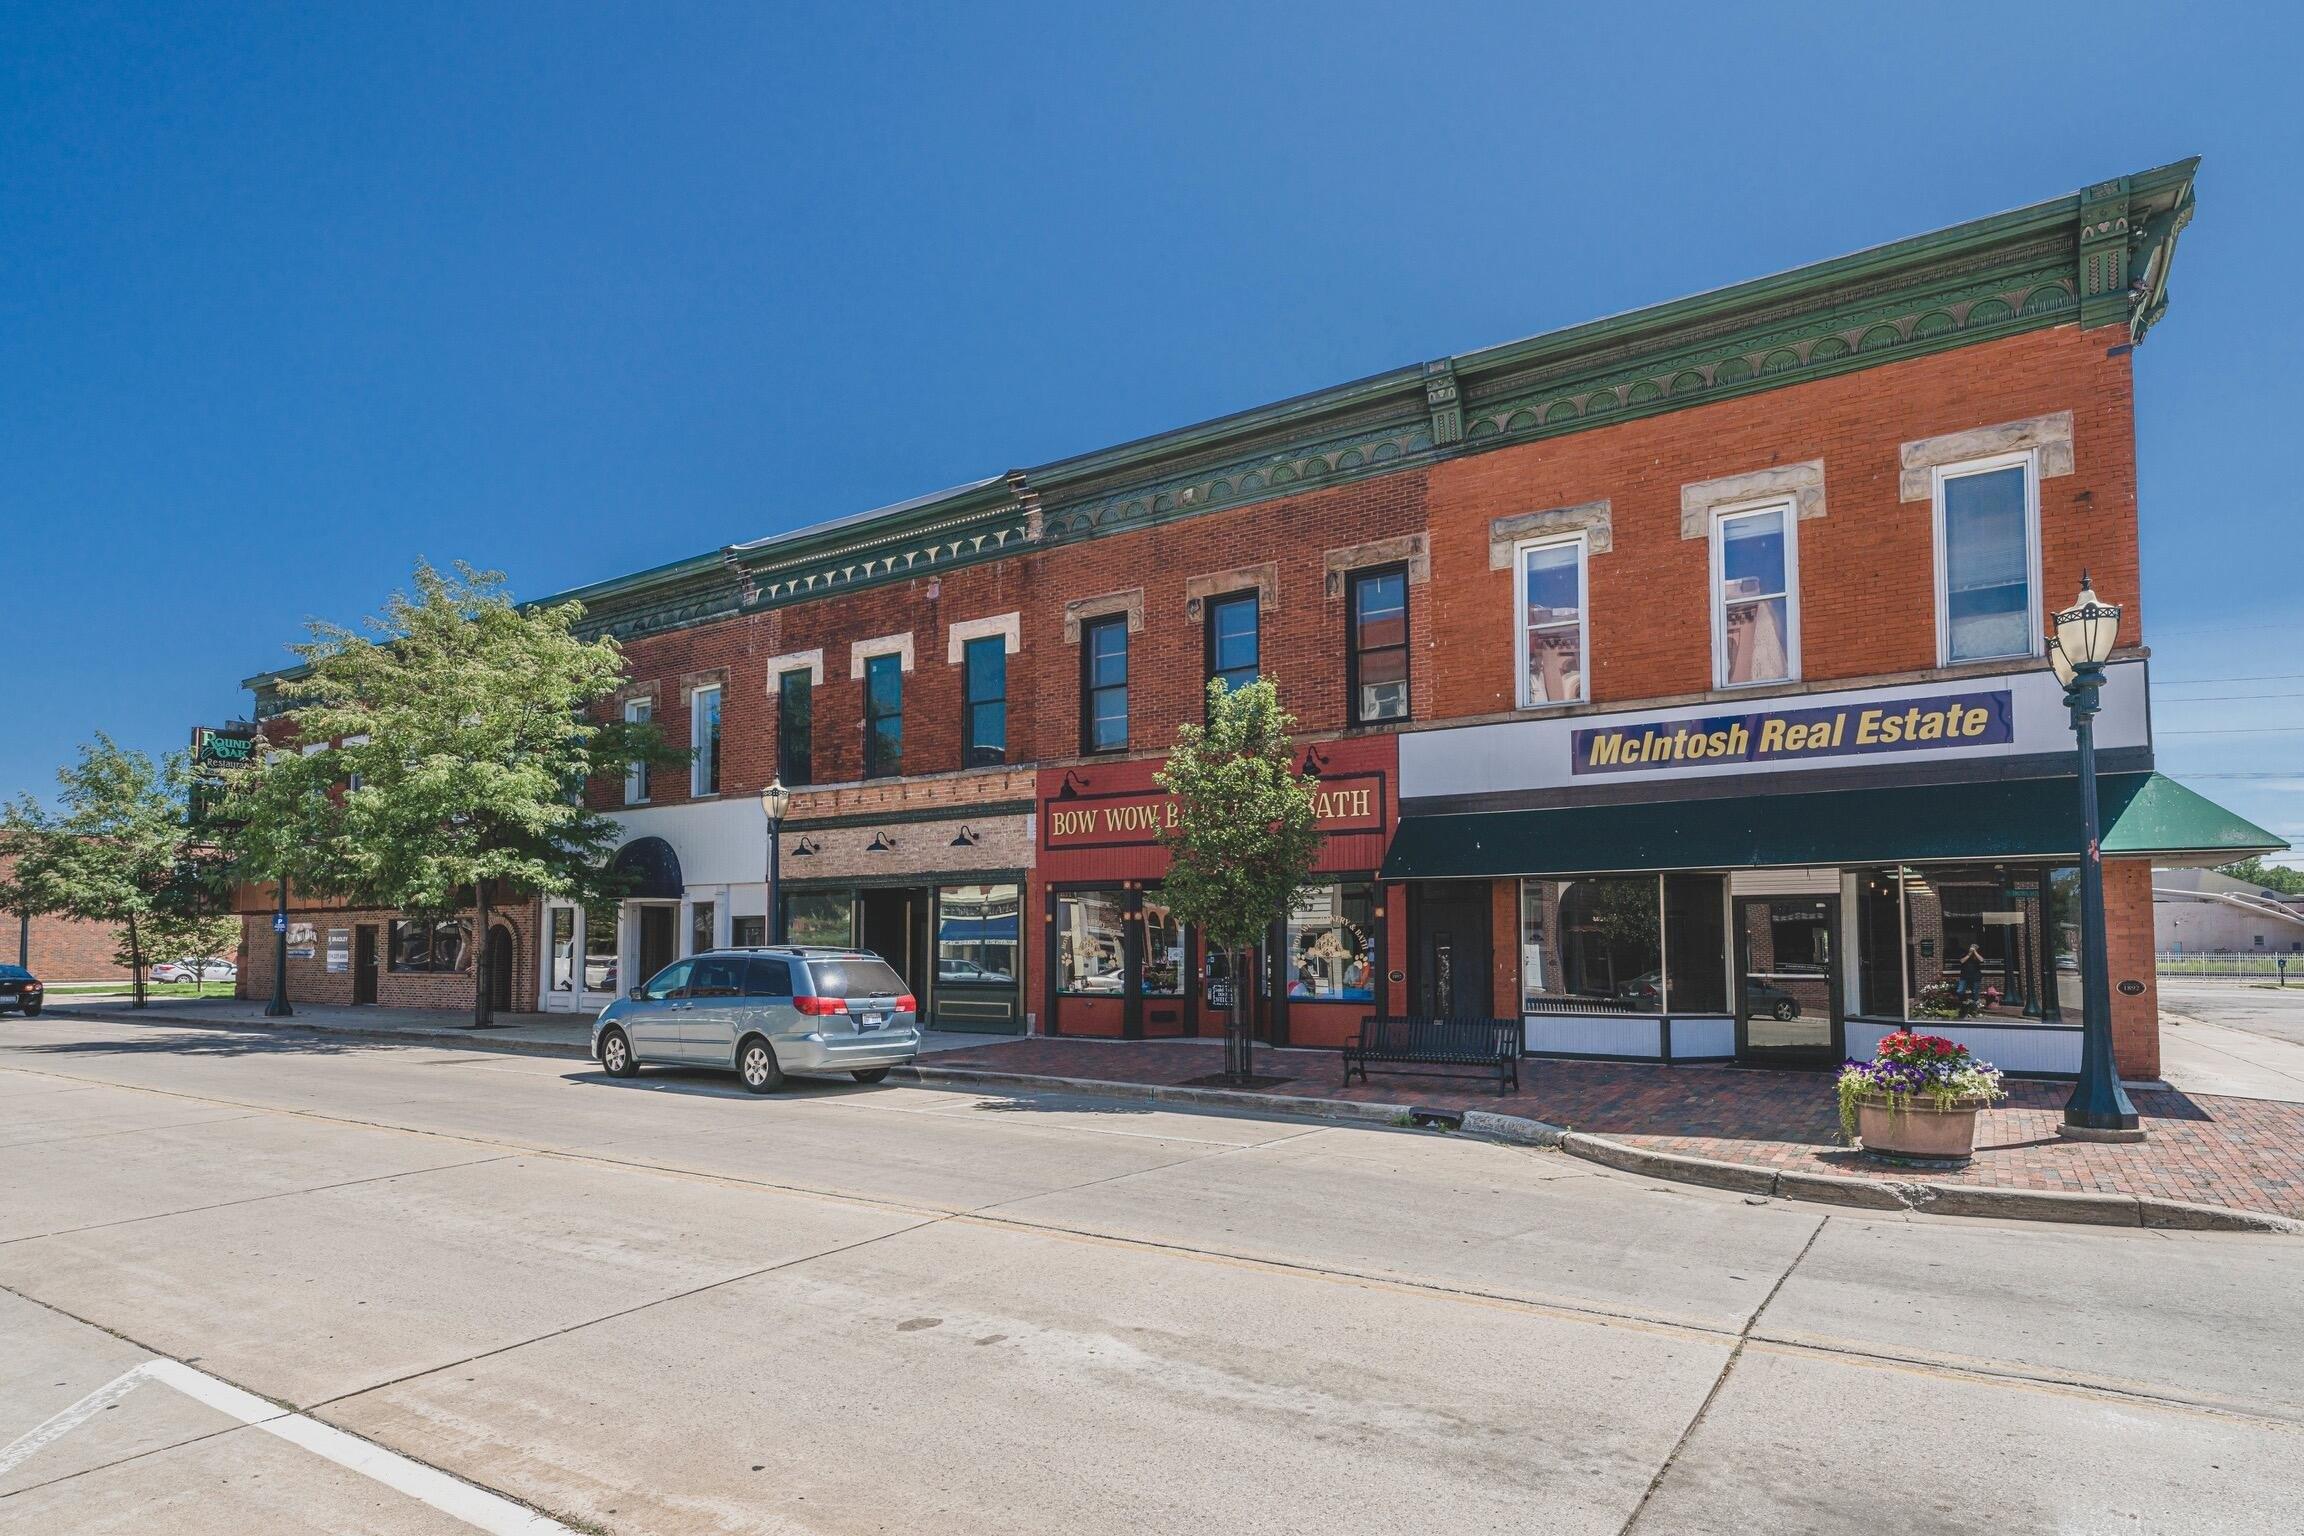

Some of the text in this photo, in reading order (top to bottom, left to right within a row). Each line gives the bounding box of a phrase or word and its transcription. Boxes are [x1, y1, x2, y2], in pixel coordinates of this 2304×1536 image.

[1589, 704, 1989, 766] McIntosh Real Estate
[1052, 810, 1098, 836] BOW
[1104, 805, 1159, 832] WOW
